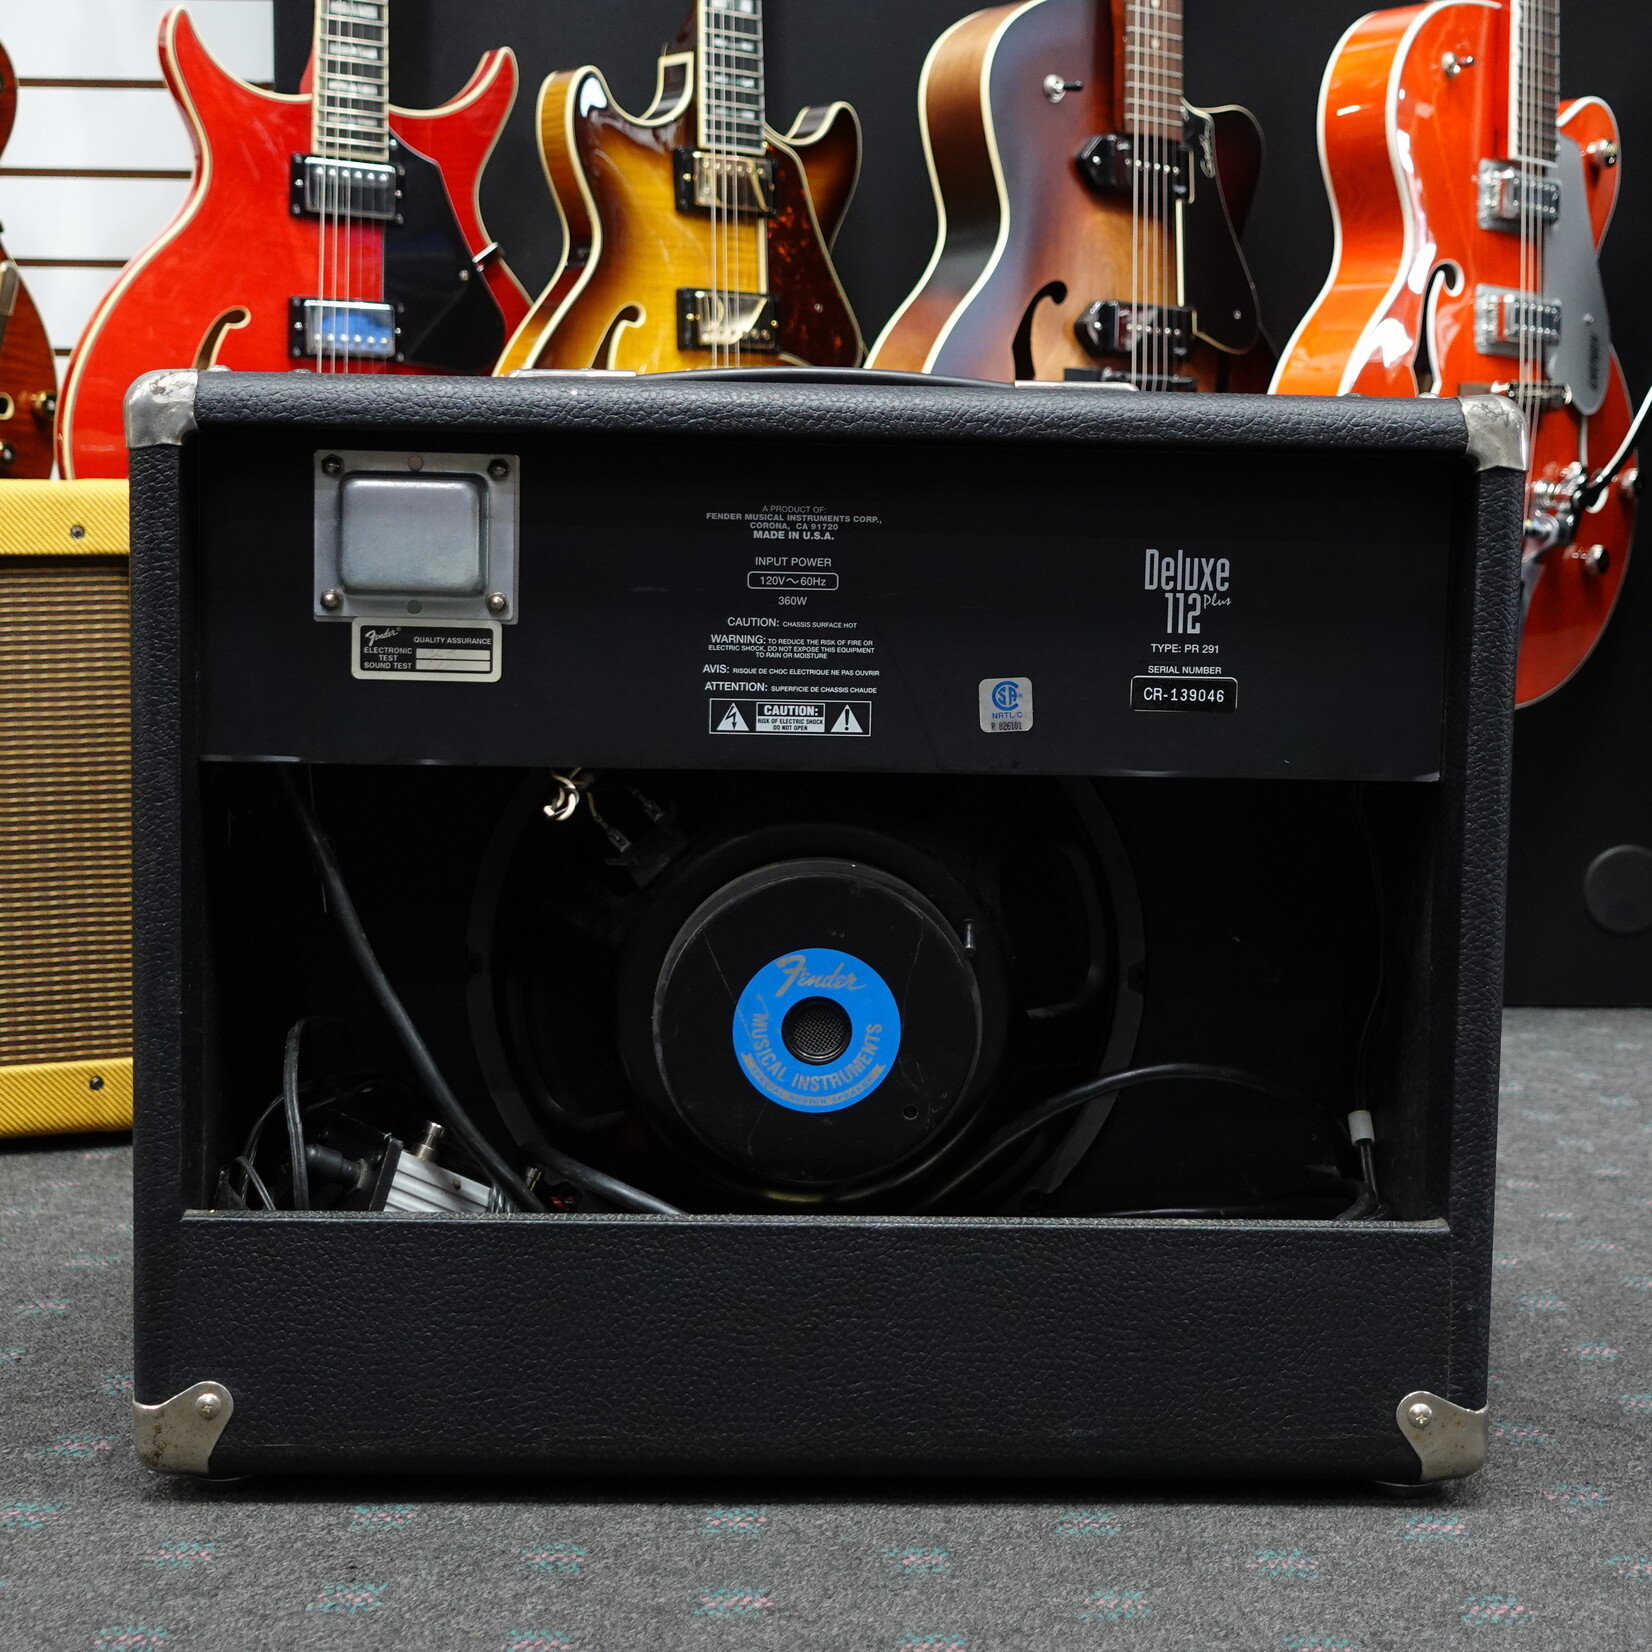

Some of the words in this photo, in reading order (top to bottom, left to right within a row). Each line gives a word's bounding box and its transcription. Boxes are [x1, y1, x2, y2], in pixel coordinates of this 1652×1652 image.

[750, 522, 790, 530] CORONA,
[753, 530, 785, 539] MADE
[803, 532, 834, 540] U.S.A.
[755, 557, 788, 566] INPUT
[791, 557, 832, 567] POWER
[1145, 549, 1230, 591] Deluxe
[778, 596, 807, 605] 360W
[1165, 593, 1201, 634] 112
[1204, 593, 1231, 609] Plus
[727, 617, 779, 627] CAUTION:
[365, 628, 398, 646] Fender
[710, 634, 766, 644] WARNING:
[1151, 643, 1182, 653] TYPE:
[1184, 644, 1199, 653] PR
[1202, 645, 1219, 654] 291
[703, 664, 730, 674] AVIS:
[704, 682, 767, 692] ATTENTION:
[1143, 687, 1224, 702] CR-139046
[764, 705, 818, 716] CAUTION:
[775, 955, 867, 997] Fender
[752, 1013, 788, 1082] MUSICAL
[792, 1023, 883, 1091] INSTRUMENTS
